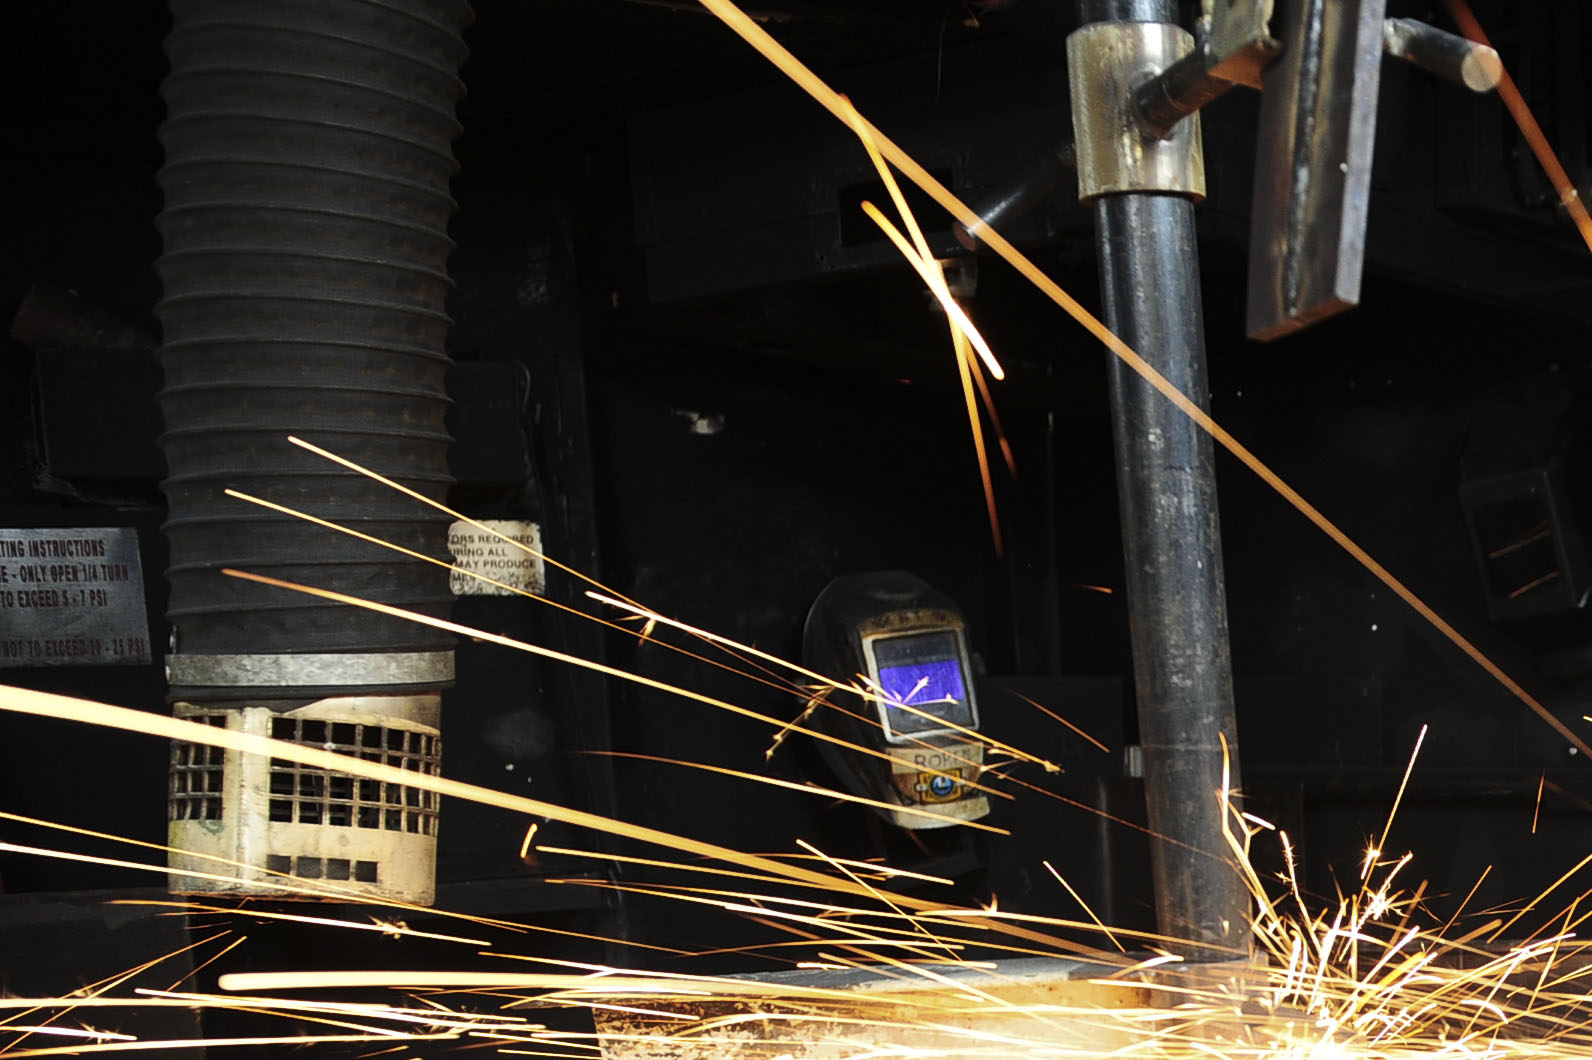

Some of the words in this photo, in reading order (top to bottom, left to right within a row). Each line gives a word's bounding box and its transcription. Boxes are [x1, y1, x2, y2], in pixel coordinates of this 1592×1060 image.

[28, 539, 105, 558] INSTRUCTIONS
[488, 548, 507, 557] ALL
[20, 565, 46, 583] ONLY
[50, 564, 79, 582] OPEN
[101, 564, 129, 581] TURN
[483, 560, 537, 569] PRODUCE
[17, 590, 59, 608] EXCEED
[90, 589, 108, 607] PSI
[27, 640, 41, 657] TO
[45, 639, 84, 657] EXCEED
[127, 637, 145, 655] PSI
